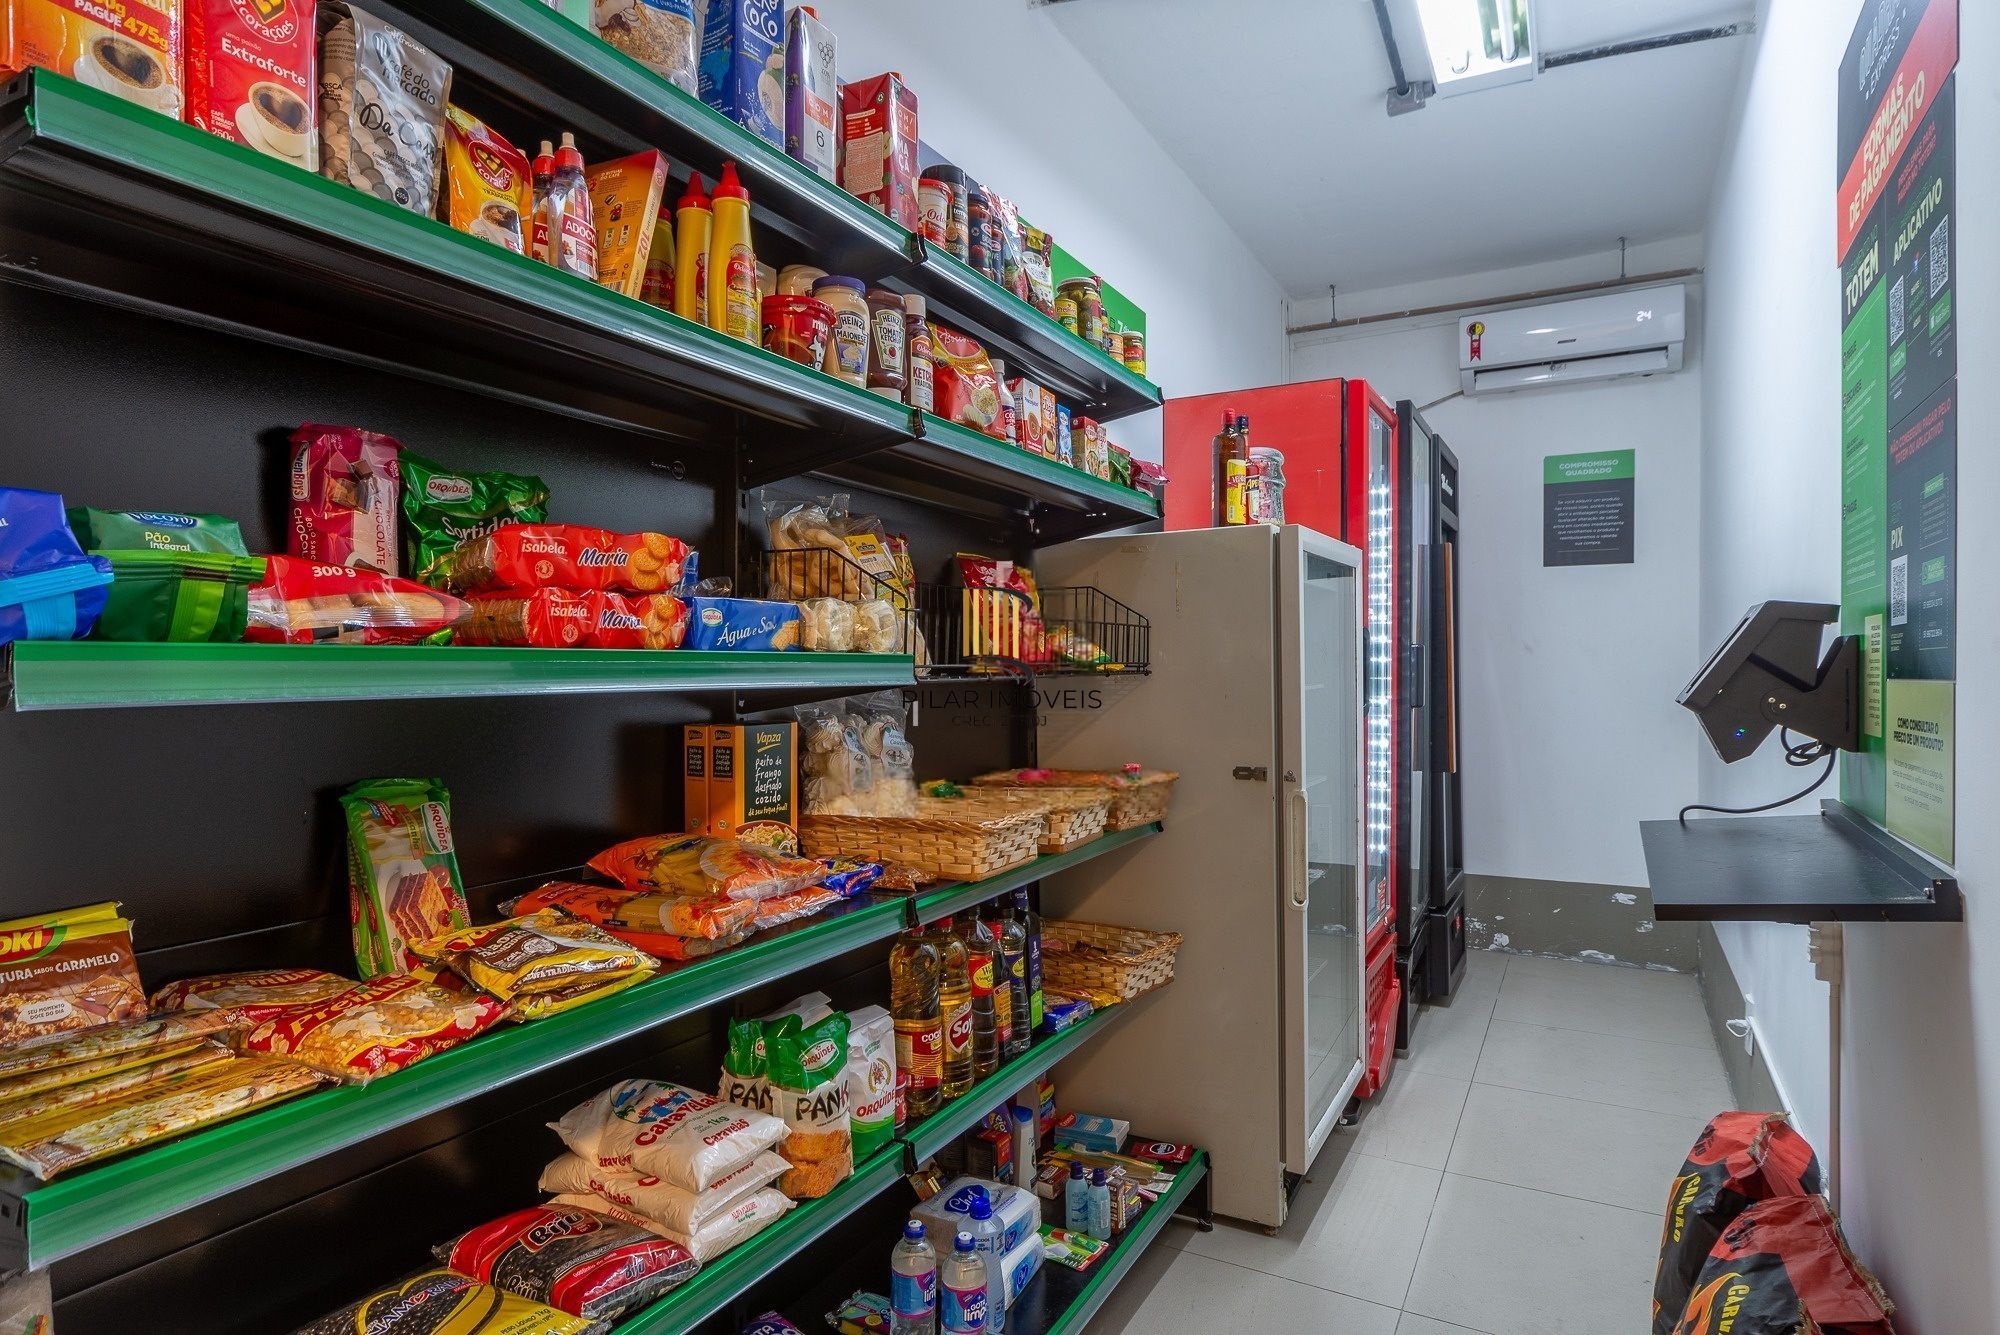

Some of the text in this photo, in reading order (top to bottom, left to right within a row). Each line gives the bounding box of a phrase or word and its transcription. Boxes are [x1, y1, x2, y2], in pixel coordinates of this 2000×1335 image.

[74, 0, 169, 51] PAGUE 475g
[221, 37, 307, 88] Extraforte
[382, 68, 436, 106] mercado
[413, 70, 430, 88] do
[359, 102, 394, 137] Da
[1863, 71, 1904, 174] FORMAS
[816, 130, 825, 148] 6
[1849, 189, 1862, 232] DE
[1860, 70, 1926, 210] PAGAMENTO
[1893, 177, 1943, 267] APLICATIVO
[1846, 239, 1879, 315] TOTEM
[841, 316, 864, 329] HEINZ
[882, 315, 900, 326] HEINZ
[1636, 310, 1652, 322] 24
[836, 328, 867, 344] MAIONESE
[1559, 459, 1619, 470] COMPROMISSO
[1565, 467, 1612, 477] QUADRADO
[145, 531, 171, 543] Pão
[150, 540, 192, 552] Integral
[1891, 526, 1903, 550] PIX
[521, 539, 566, 554] isabela
[577, 548, 628, 567] Maria
[312, 565, 357, 579] 300 g
[550, 604, 590, 617] isabela
[600, 609, 641, 628] Maria
[717, 621, 750, 647] Água
[757, 731, 782, 745] Vapza
[755, 755, 782, 769] peito de
[755, 768, 782, 782] frango
[755, 779, 782, 793] desfiado
[755, 791, 782, 805] cozido
[428, 803, 450, 852] ORQUÍDEA
[34, 966, 54, 975] SABOR
[55, 952, 119, 973] CARAMELO
[30, 1012, 45, 1020] DOCE
[55, 1008, 65, 1016] DIA
[38, 1002, 65, 1013] MOMENTO
[802, 1043, 836, 1067] ORQUÍDEA
[703, 1118, 751, 1147] Caravelas
[949, 1187, 980, 1213] Chef
[528, 1211, 585, 1246] Biju
[501, 1308, 552, 1335] PESO LÍQUIDO 1kg
